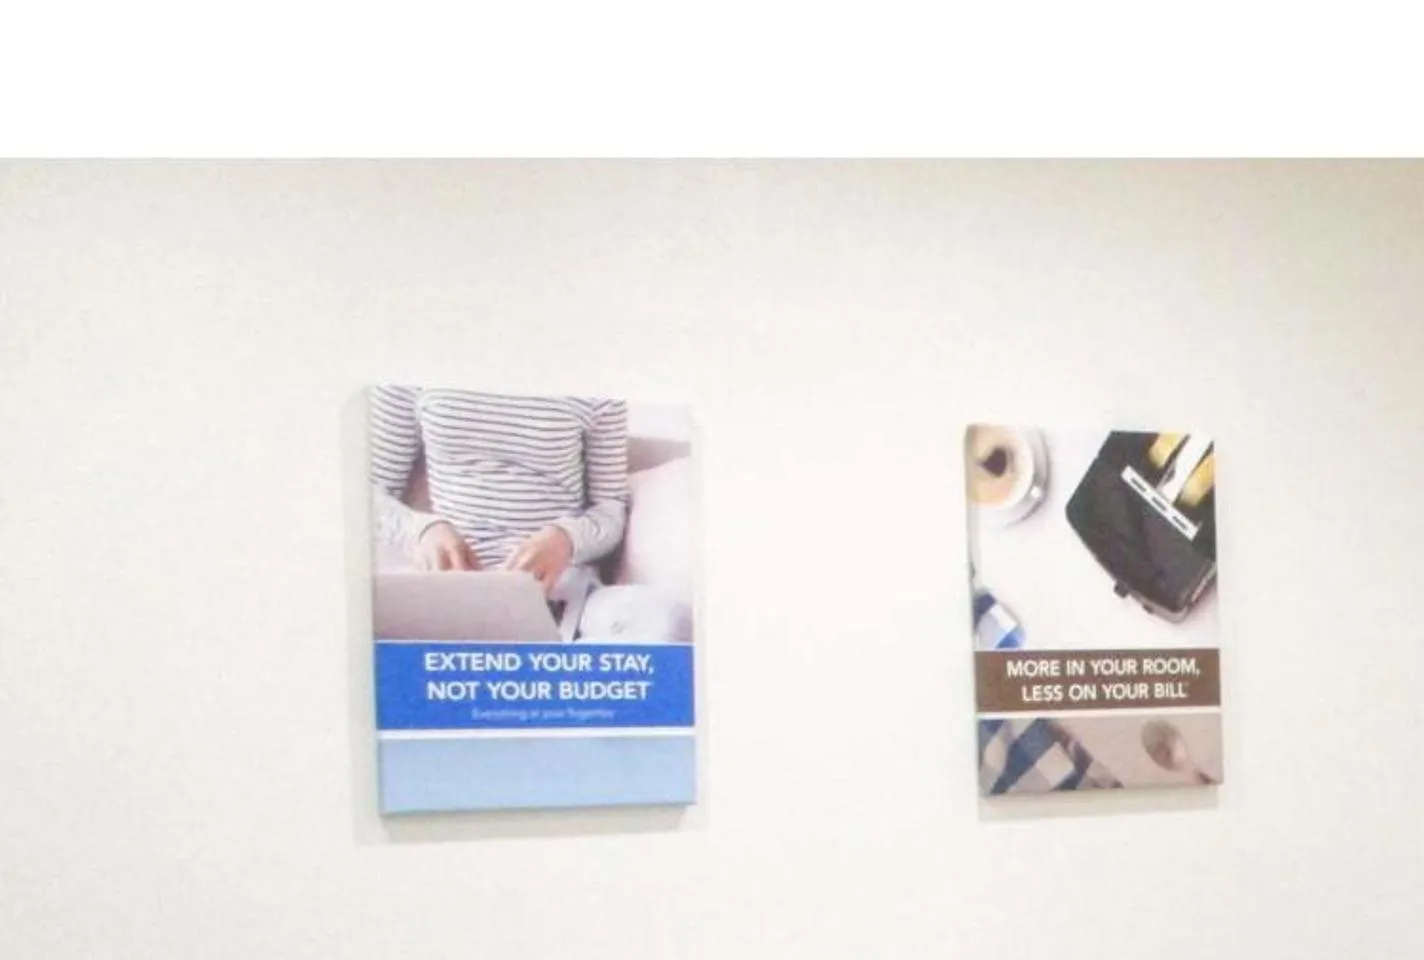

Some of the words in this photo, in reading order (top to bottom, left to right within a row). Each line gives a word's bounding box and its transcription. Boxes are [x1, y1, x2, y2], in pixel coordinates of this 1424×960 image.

[424, 653, 521, 672] EXTEND
[528, 653, 592, 672] YOUR
[599, 653, 654, 675] STAY,
[1006, 660, 1061, 677] MORE
[1066, 660, 1085, 676] IN
[1090, 659, 1137, 676] YOUR
[1142, 658, 1201, 677] ROOM,
[427, 682, 479, 700] NOT
[488, 682, 550, 700] YOUR
[559, 681, 651, 700] BUDGET
[1021, 685, 1063, 702] LESS
[1068, 684, 1097, 700] ON
[1101, 683, 1149, 700] YOUR
[1154, 682, 1187, 699] BILL
